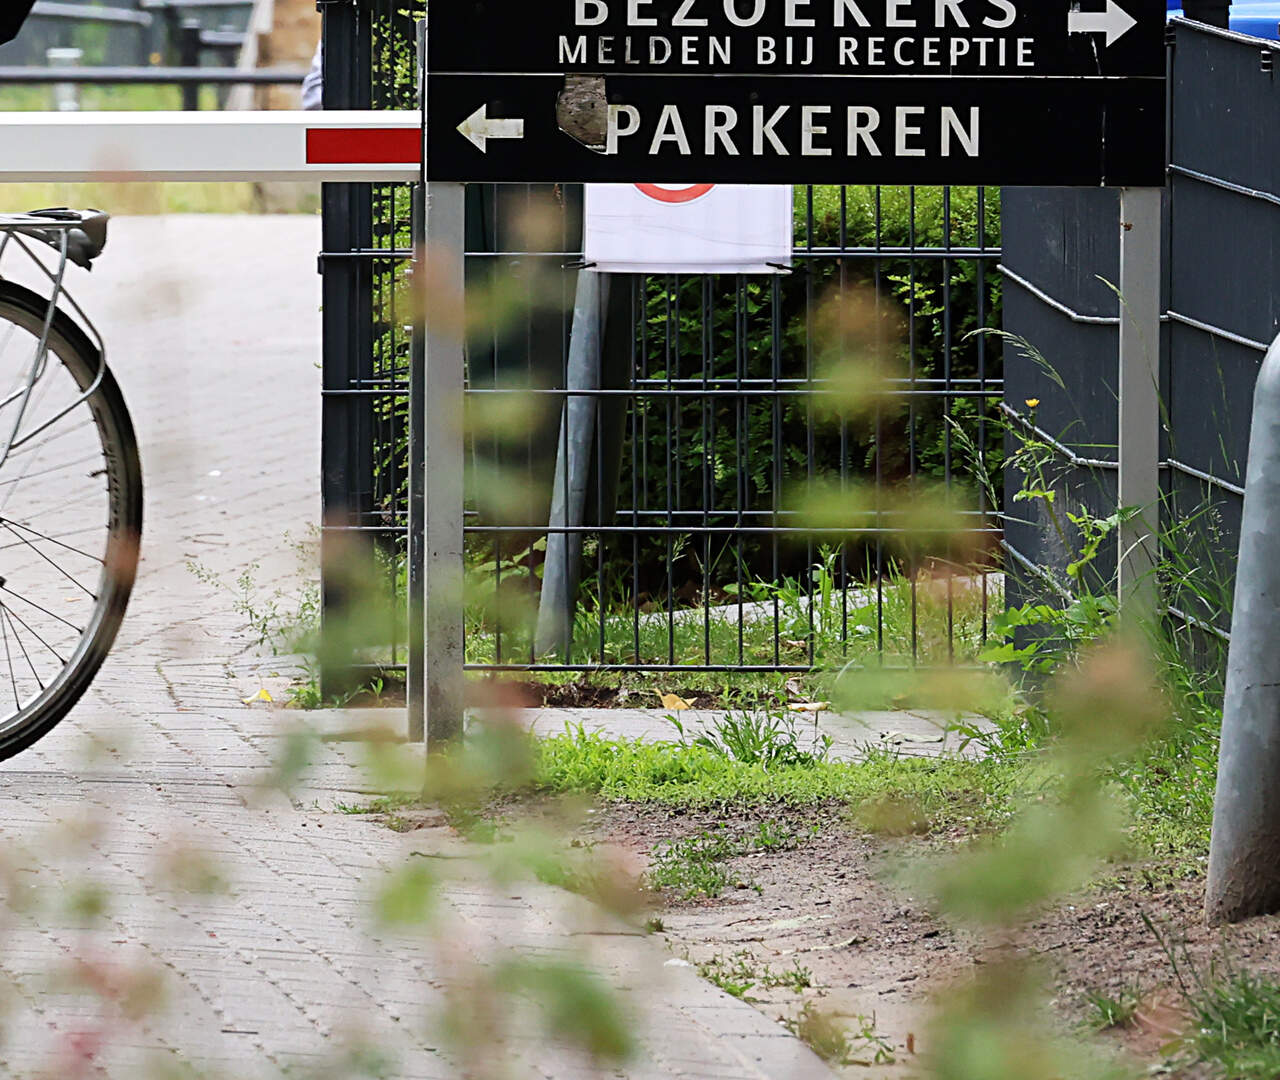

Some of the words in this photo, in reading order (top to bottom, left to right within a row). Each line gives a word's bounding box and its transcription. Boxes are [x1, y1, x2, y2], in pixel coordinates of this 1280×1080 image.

[558, 35, 731, 67] MELDEN
[757, 35, 813, 67] BIJ
[839, 35, 1035, 67] RECEPTIE
[608, 104, 980, 157] PARKEREN
